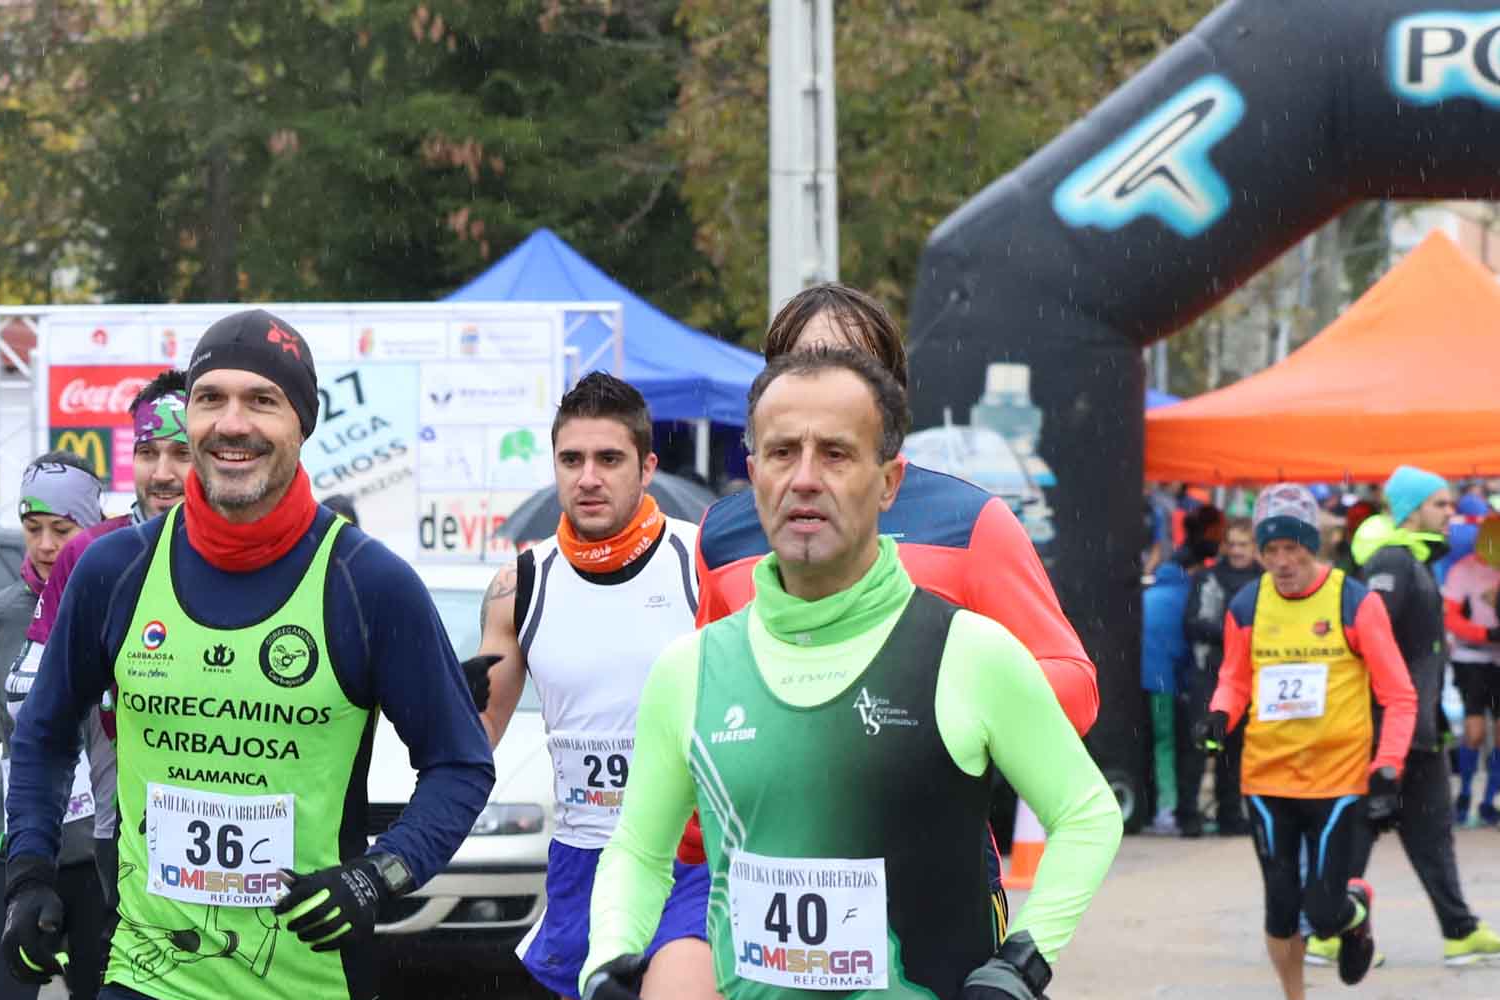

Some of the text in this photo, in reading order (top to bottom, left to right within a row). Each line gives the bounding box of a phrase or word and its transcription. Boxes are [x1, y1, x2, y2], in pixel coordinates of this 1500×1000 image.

[60, 378, 148, 414] Coca-C
[317, 371, 365, 423] 27
[319, 415, 390, 455] LIGA
[314, 438, 408, 490] CROSS
[127, 652, 174, 661] CARBAJOSA
[1278, 679, 1303, 700] 22
[123, 692, 332, 726] CORRECAMINOS
[143, 728, 300, 760] CARBAJOSA
[587, 740, 611, 752] CROSS
[167, 766, 268, 788] SALAMANCA
[583, 754, 629, 788] 29
[175, 797, 195, 814] LIGA
[197, 801, 226, 817] CROSS
[227, 800, 287, 821] CABRERIZOS
[186, 820, 244, 869] 36
[249, 838, 271, 863] C
[751, 864, 769, 885] LIGA
[771, 868, 805, 887] CROSS
[807, 871, 878, 888] CABRERIZOS
[211, 894, 275, 905] REFORMA
[764, 892, 828, 946] 40
[739, 940, 873, 975] JOMISAGA
[794, 974, 872, 986] REFORMAS
